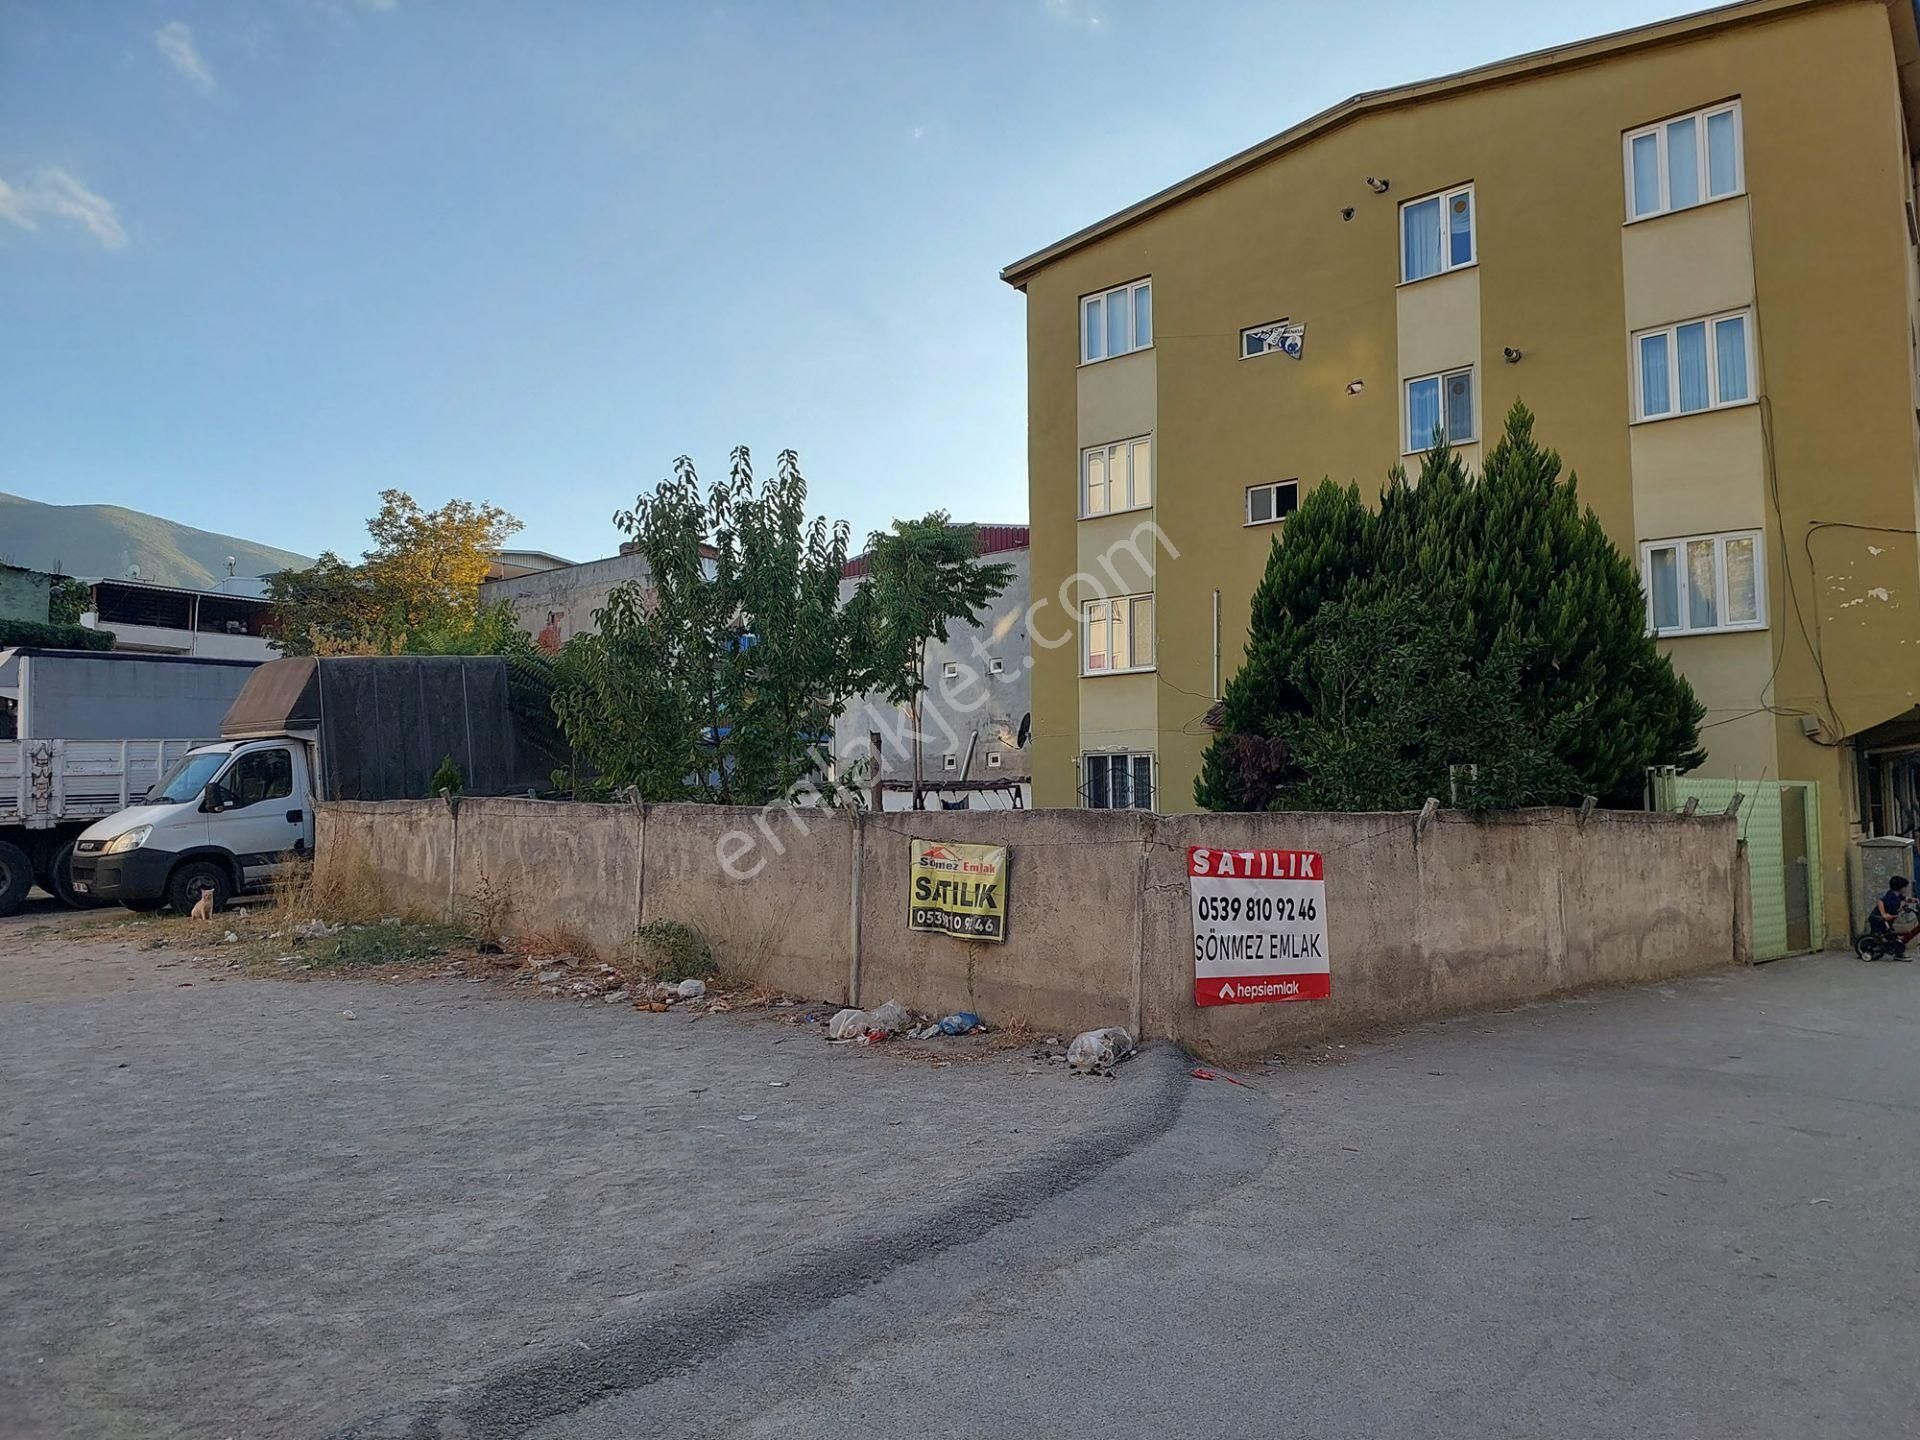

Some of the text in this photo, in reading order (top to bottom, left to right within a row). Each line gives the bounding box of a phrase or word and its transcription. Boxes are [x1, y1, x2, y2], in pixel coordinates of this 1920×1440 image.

[963, 861, 995, 874] Emlak
[1192, 849, 1314, 878] SATILIK
[915, 876, 998, 909] SATILIK
[1199, 896, 1241, 921] 0539
[1246, 897, 1272, 921] 810
[1195, 928, 1322, 961] SÖNMEZ EMLAK
[1237, 980, 1299, 999] hepsiemlak
